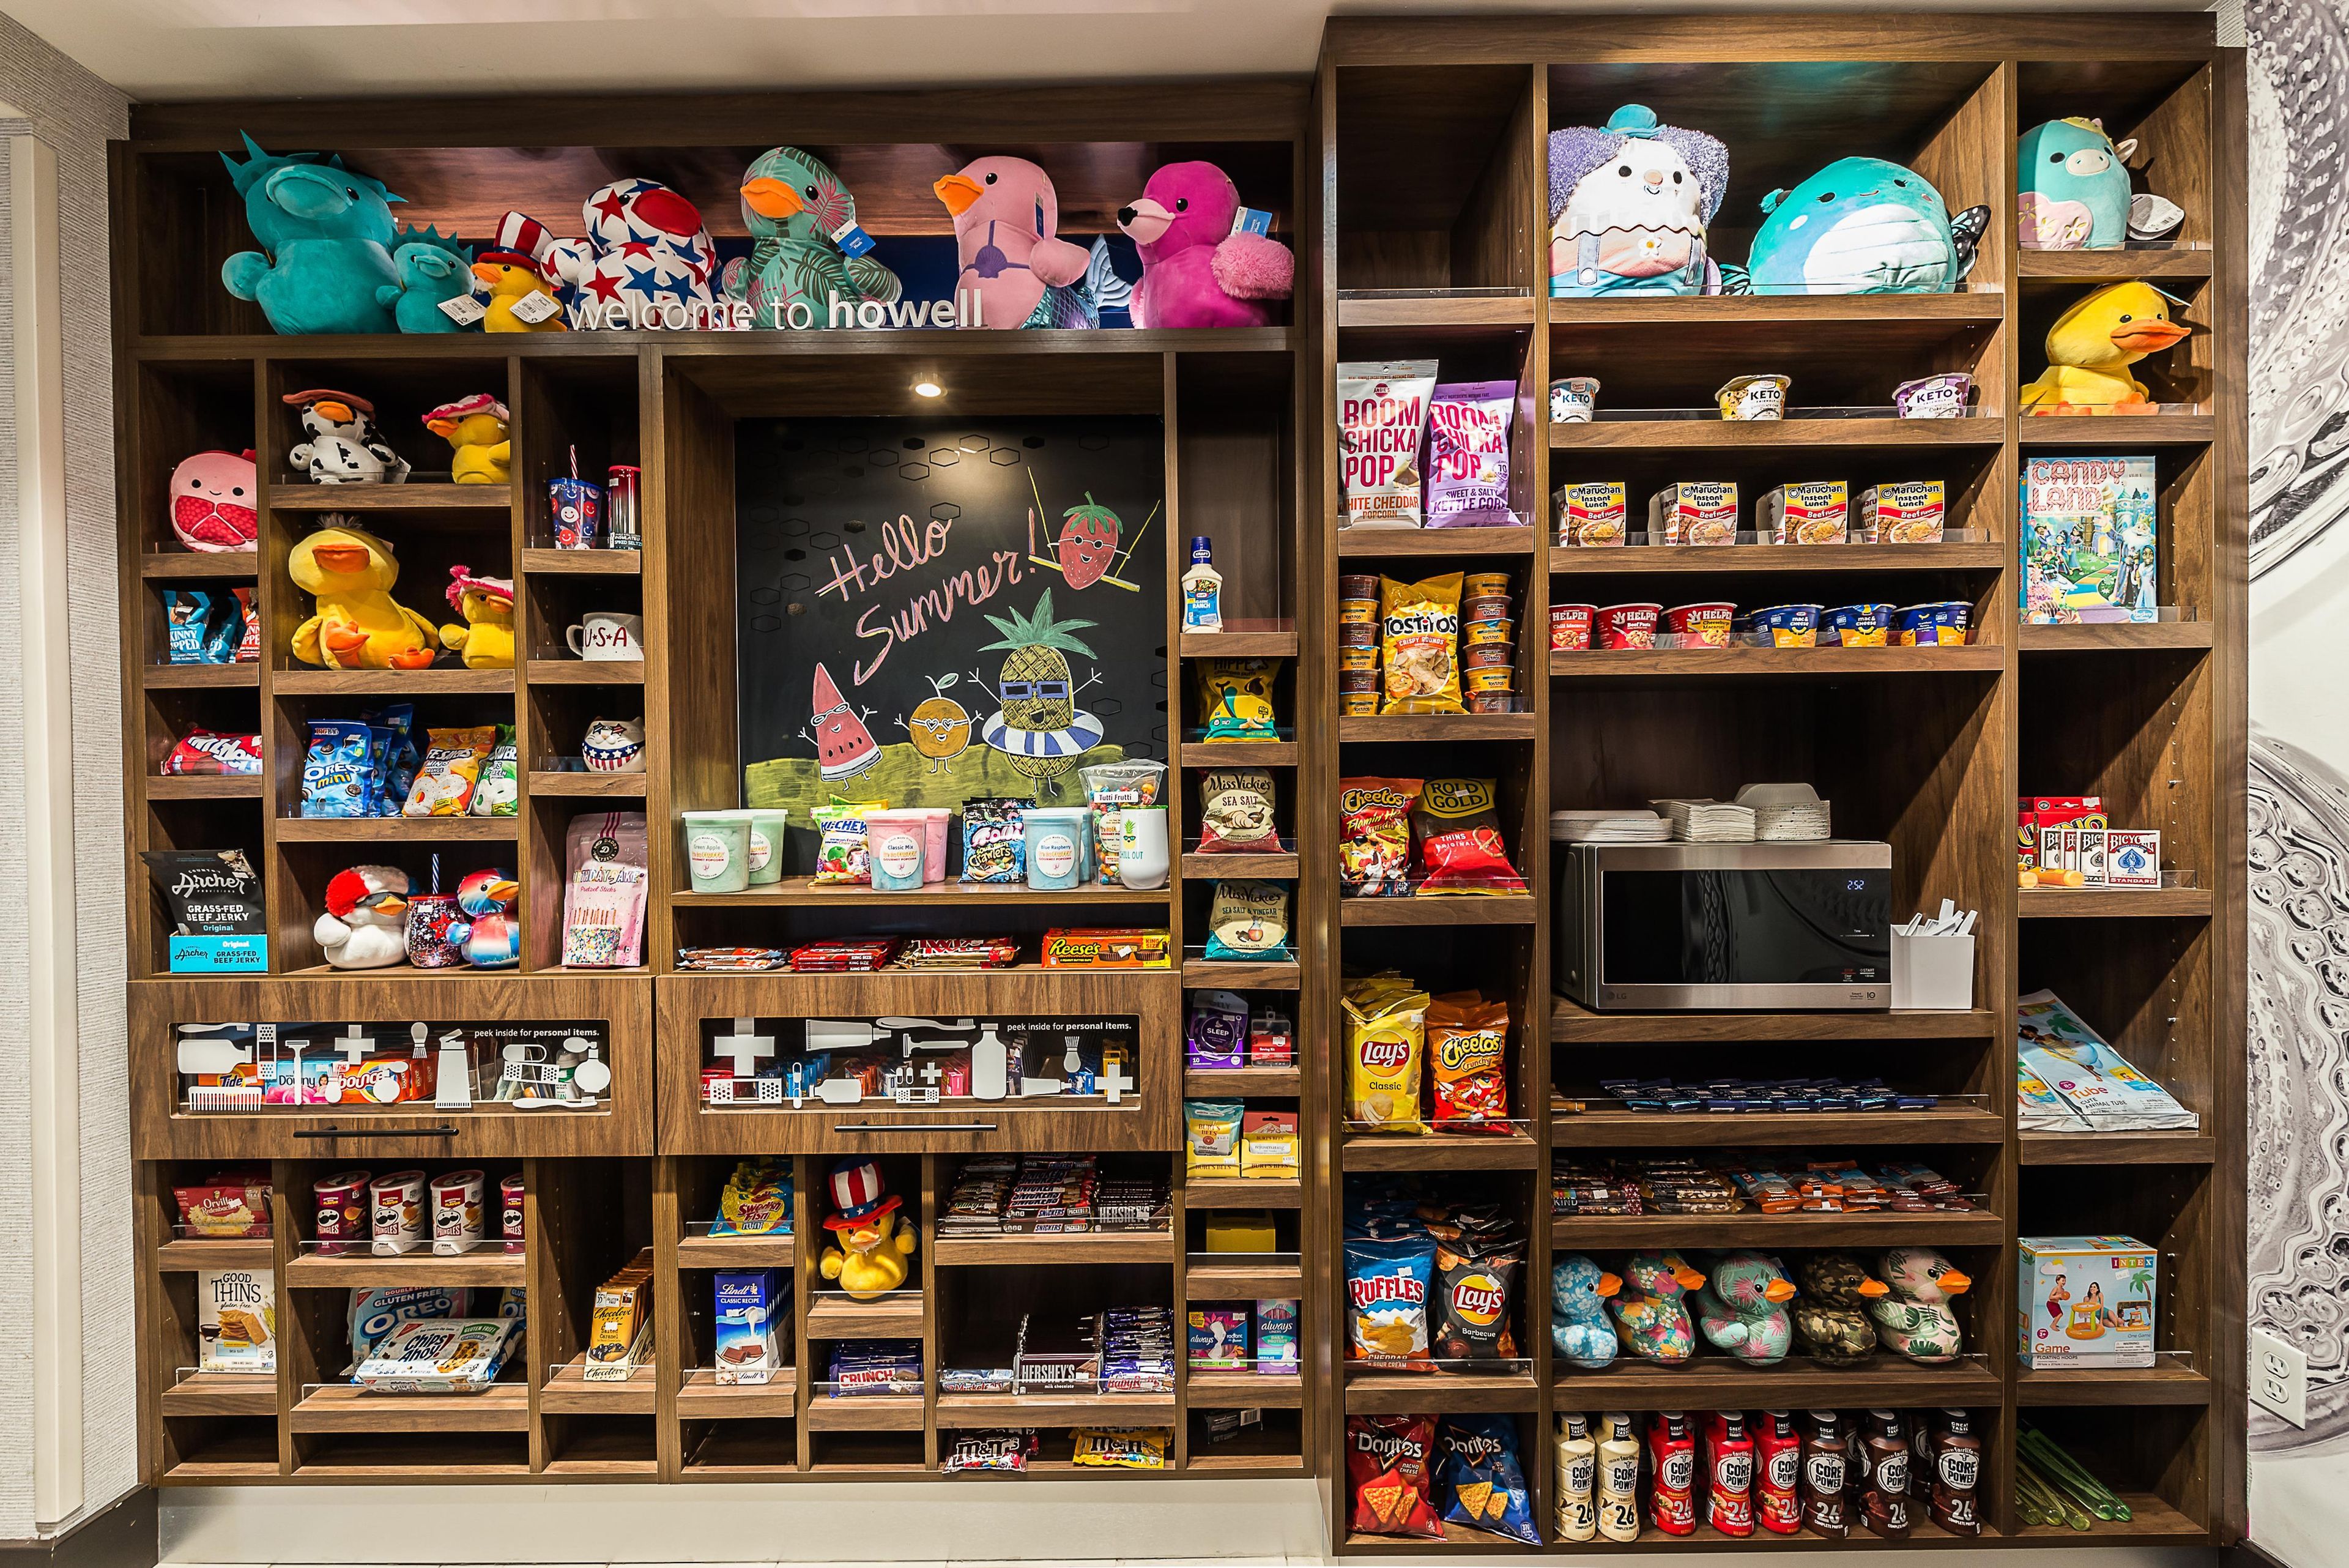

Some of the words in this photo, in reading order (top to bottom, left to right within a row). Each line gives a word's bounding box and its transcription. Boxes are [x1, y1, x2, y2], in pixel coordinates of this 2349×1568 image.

[566, 292, 754, 331] welcome
[774, 295, 813, 331] to
[829, 289, 981, 328] howell
[1562, 393, 1590, 403] KETO
[1751, 390, 1781, 400] KETO
[1344, 396, 1420, 429] BOOM
[1345, 428, 1417, 454] CHICKA
[1345, 455, 1395, 488] POP
[2032, 460, 2125, 485] CANDY
[1445, 488, 1468, 499] SWEET
[1470, 488, 1476, 497] &
[1478, 488, 1498, 497] SALTY
[1578, 485, 1622, 495] Maruchan
[1690, 485, 1733, 494] Maruchan
[2032, 487, 2102, 511] LAND
[1362, 510, 1397, 519] POPCORN
[1587, 511, 1605, 519] Beef
[815, 514, 952, 602] Hello
[854, 507, 1036, 686] Summer!
[1552, 612, 1587, 621] HELPER
[1627, 611, 1657, 622] HELPER
[1398, 637, 1419, 647] CRISPY
[1421, 637, 1444, 645] ROUNDS
[305, 764, 361, 779] OREO
[317, 771, 352, 789] mini
[1208, 776, 1236, 791] Miss
[1234, 773, 1271, 794] Vickie's
[1431, 782, 1479, 795] ROLD
[1222, 797, 1238, 806] SEA
[1240, 796, 1258, 806] SALT
[1343, 789, 1405, 815] Cheetos
[1433, 795, 1483, 808] GOLD
[1440, 833, 1466, 842] THINS
[969, 847, 1011, 867] Crawlers
[172, 873, 245, 898] Archer
[1847, 880, 1865, 890] 2:52
[186, 913, 212, 921] BEEF
[1048, 938, 1101, 956] Reese's
[475, 1029, 493, 1038] peek
[533, 1028, 570, 1038] personal
[1008, 1023, 1026, 1033] peek
[1066, 1022, 1102, 1031] personal
[1207, 1027, 1230, 1036] SLEEP
[1363, 1040, 1408, 1068] Lay's
[1461, 1057, 1491, 1071] Crunchy
[220, 1074, 243, 1087] Tide
[339, 1071, 383, 1091] bounce
[1369, 1082, 1401, 1091] Classic
[2068, 1087, 2109, 1100] Tube
[737, 1200, 782, 1217] Swedish
[1037, 1208, 1065, 1217] SNICKERS
[743, 1211, 770, 1221] Fish
[317, 1224, 339, 1235] PRINGLES
[374, 1225, 398, 1235] PRINGLES
[2112, 1257, 2154, 1269] INTEX
[223, 1273, 251, 1284] GOOD
[210, 1278, 261, 1303] THINS
[719, 1284, 749, 1295] Lindt
[1349, 1277, 1424, 1307] RUFFLES
[374, 1294, 415, 1307] GLUTEN
[417, 1288, 442, 1299] FREE
[1457, 1286, 1502, 1314] Lay's
[594, 1307, 633, 1319] Chocolove
[1261, 1321, 1293, 1334] always
[1462, 1328, 1496, 1338] Barbecue
[405, 1334, 448, 1350] Chips
[1190, 1336, 1214, 1345] always
[2035, 1343, 2070, 1353] Game
[840, 1370, 893, 1387] CRUNCH
[1021, 1364, 1075, 1383] HERSHEY'S
[1359, 1432, 1422, 1458] Doritos
[1726, 1475, 1750, 1486] POWER
[1615, 1503, 1635, 1525] 26
[1727, 1500, 1749, 1522] 26
